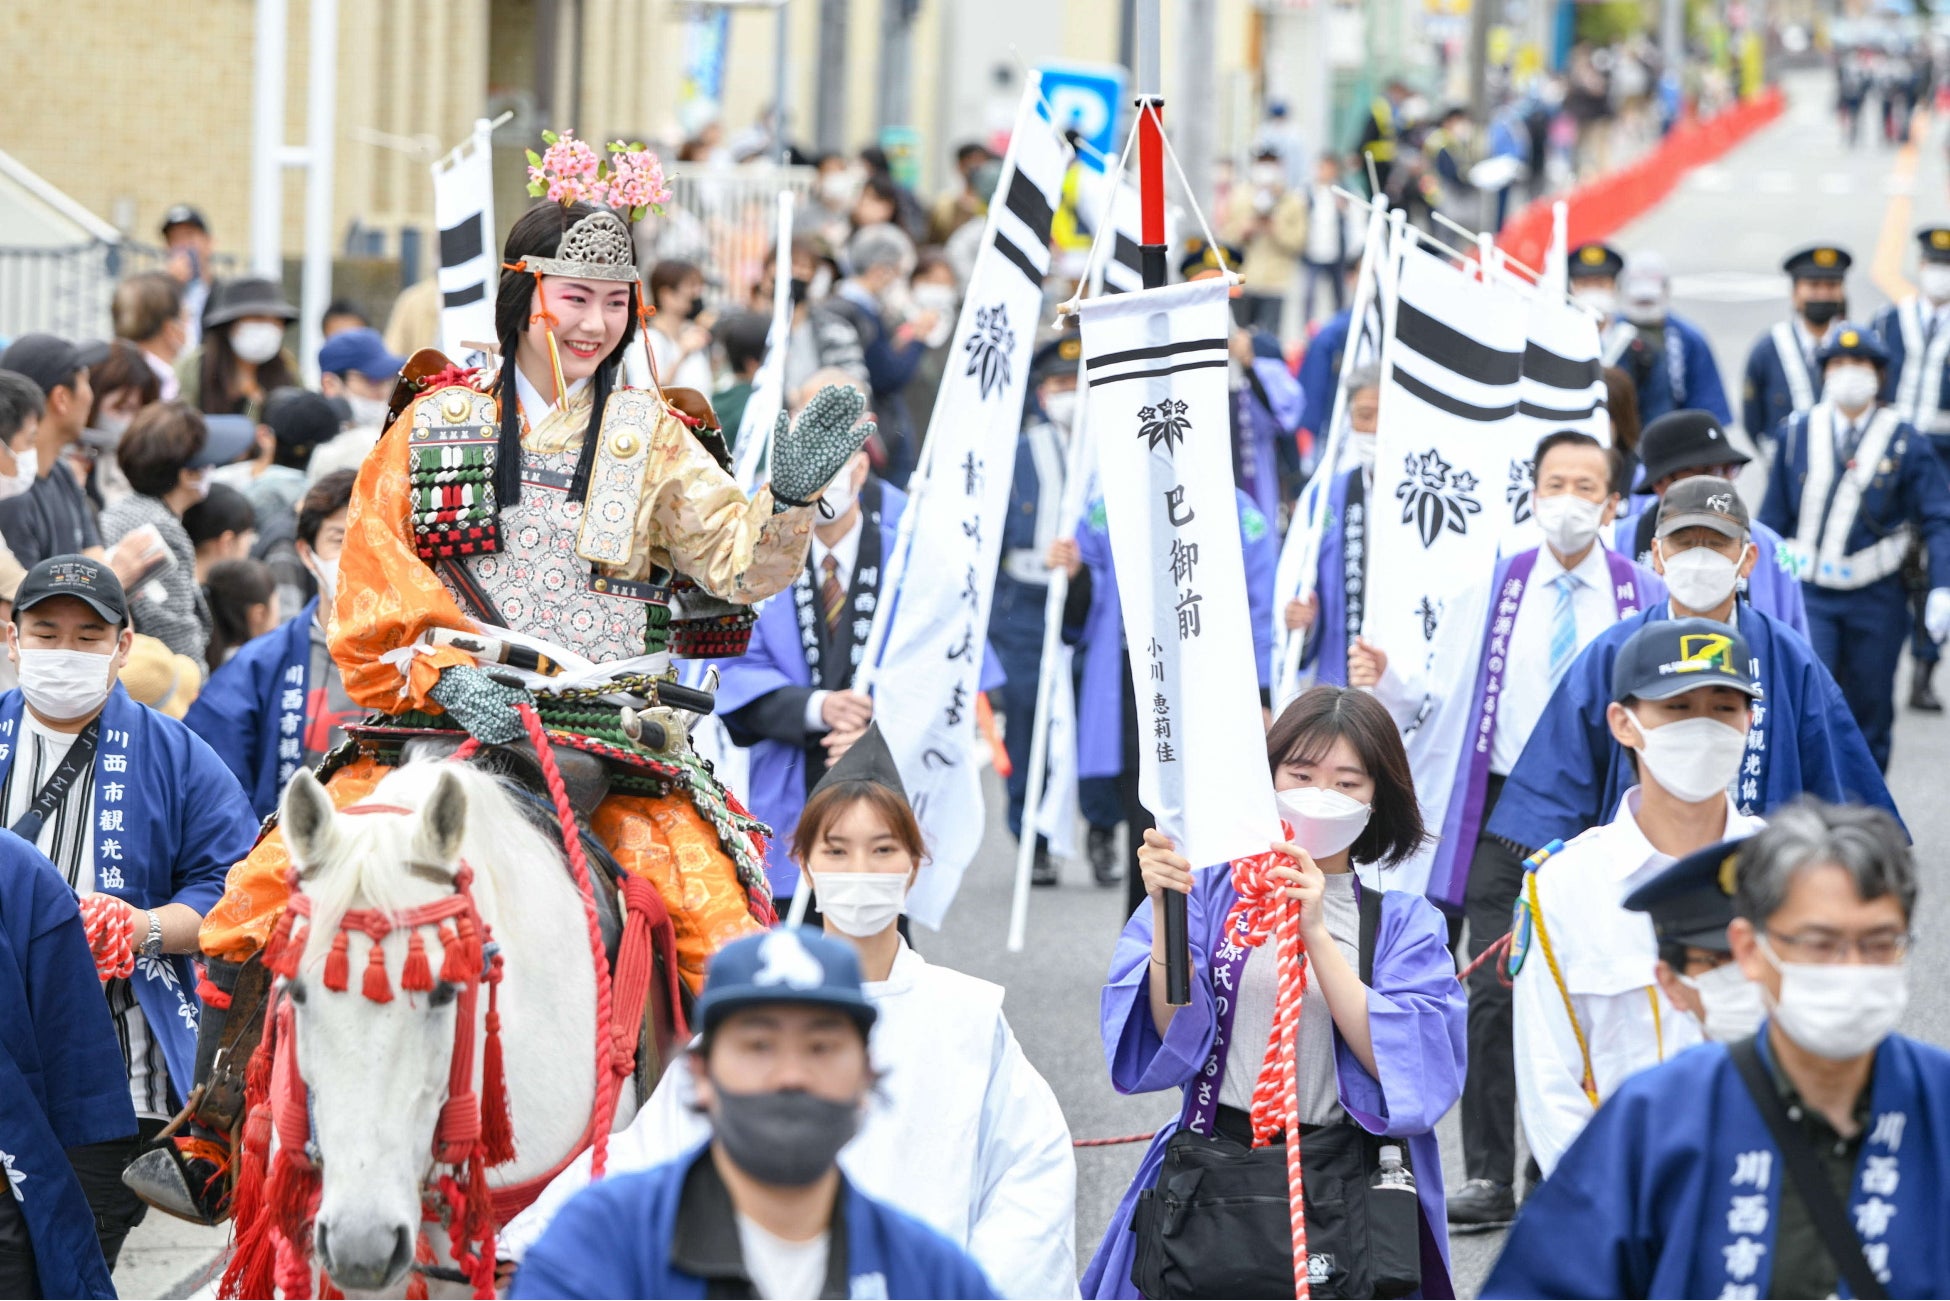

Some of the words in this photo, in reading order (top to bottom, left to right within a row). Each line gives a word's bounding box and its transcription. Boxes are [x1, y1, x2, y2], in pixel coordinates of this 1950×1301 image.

[1164, 484, 1203, 640] 巴御前
[1147, 637, 1164, 682] 小川
[1152, 692, 1176, 763] 恵莉佳
[99, 729, 129, 889] 川西市観光協
